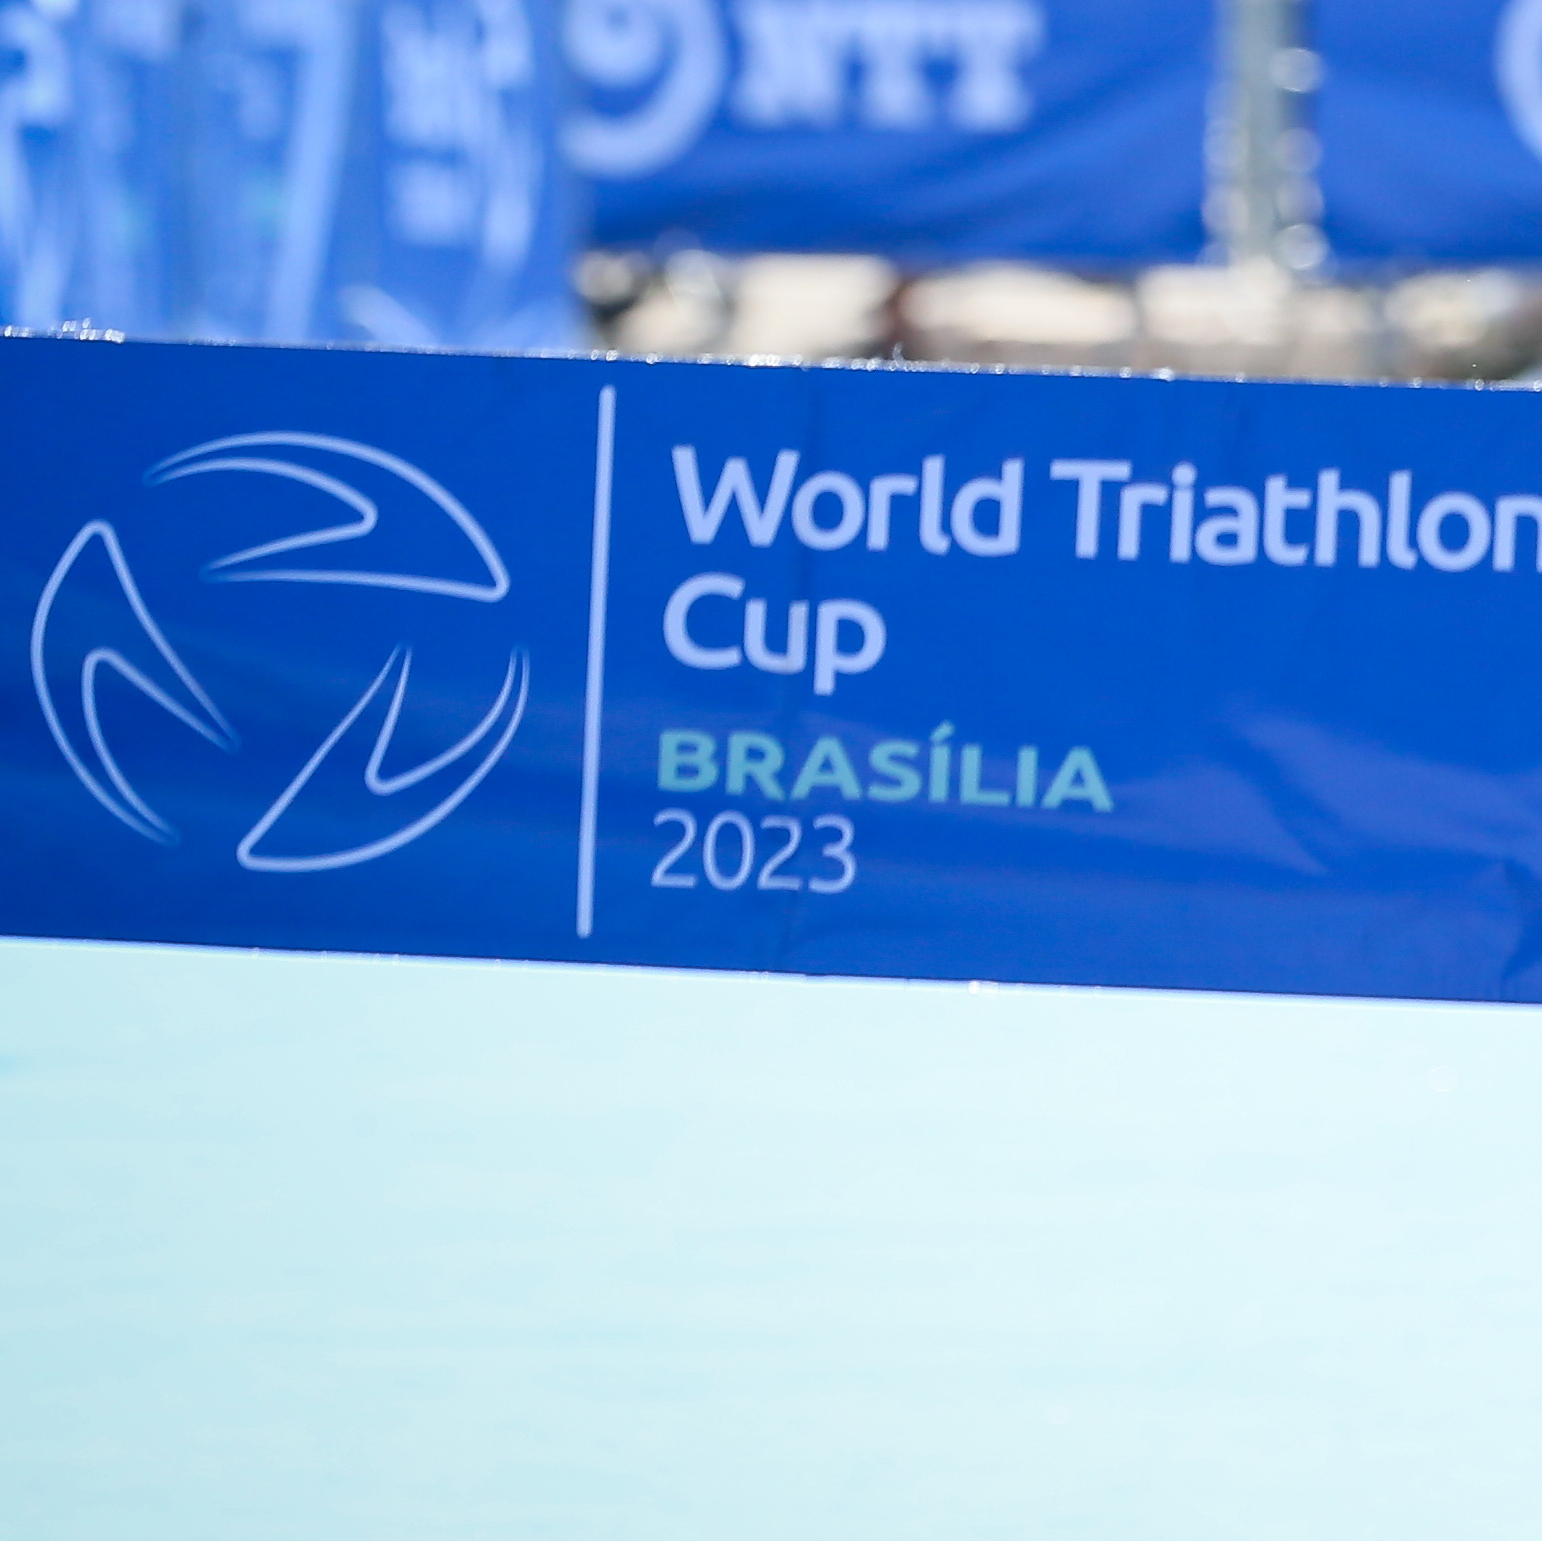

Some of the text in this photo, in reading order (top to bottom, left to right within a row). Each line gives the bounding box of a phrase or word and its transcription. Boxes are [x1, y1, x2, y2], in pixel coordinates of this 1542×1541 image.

[671, 445, 1025, 557] World
[663, 572, 887, 696] Cup
[657, 722, 1114, 812] BRASÍLIA
[651, 808, 857, 894] 2023
